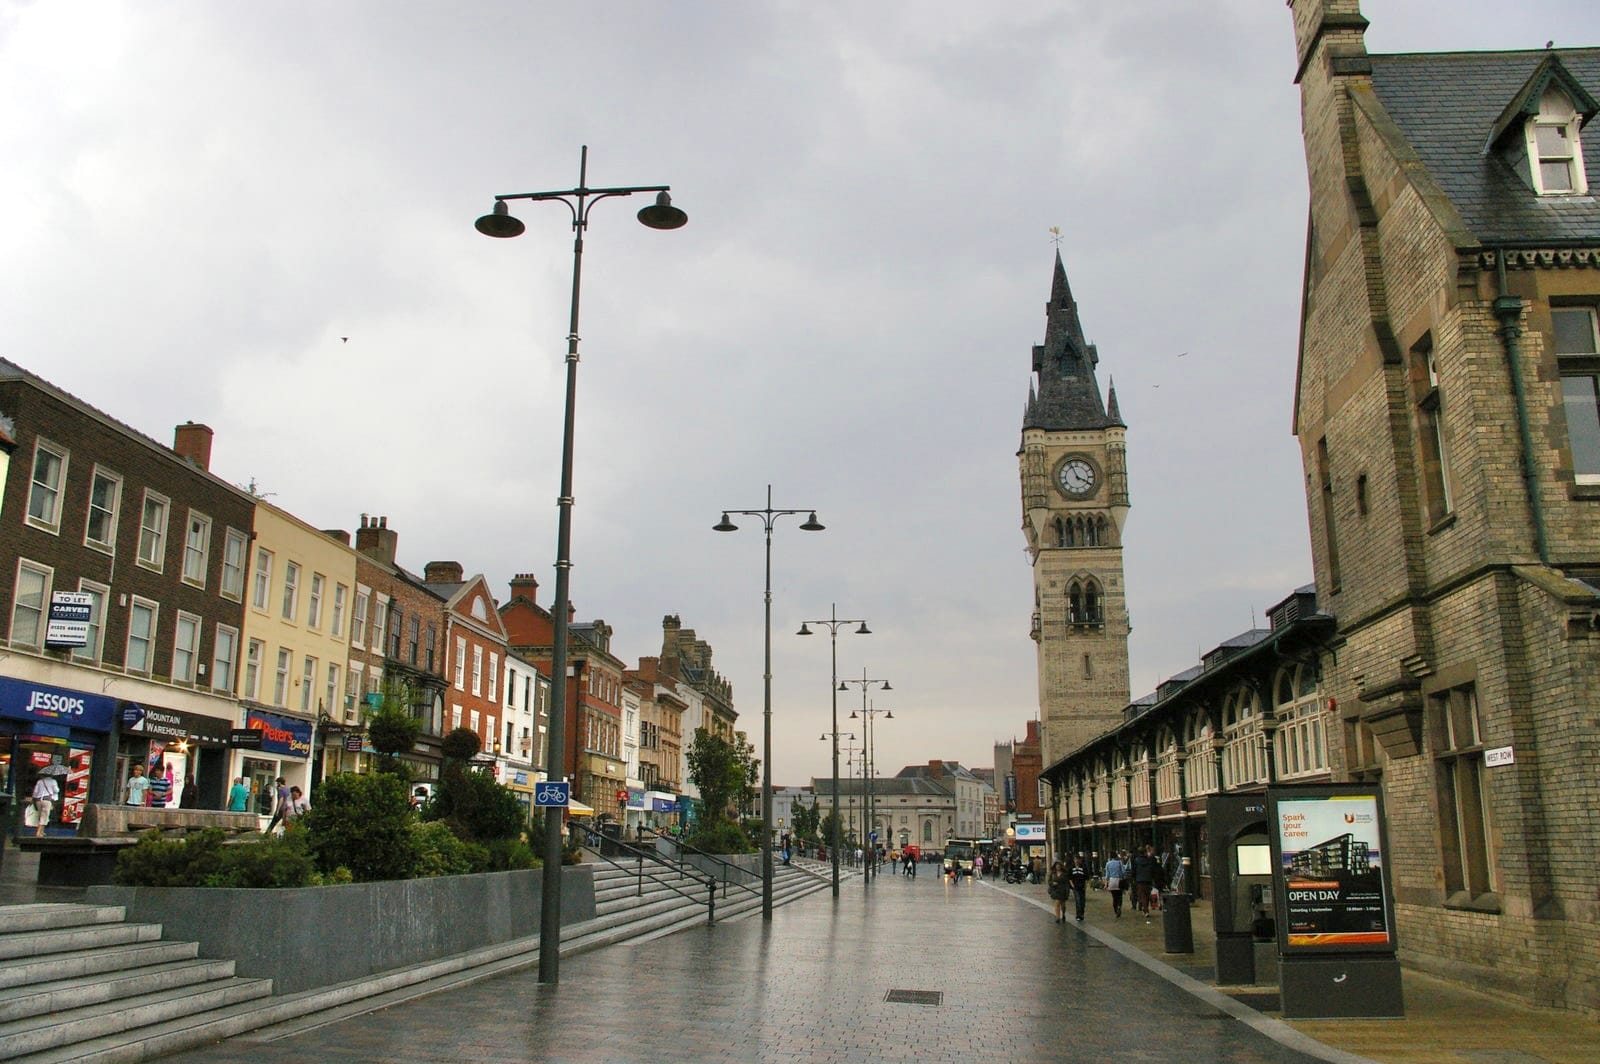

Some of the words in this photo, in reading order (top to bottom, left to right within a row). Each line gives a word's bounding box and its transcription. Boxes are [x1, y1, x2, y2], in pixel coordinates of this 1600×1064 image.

[26, 691, 84, 715] JESSOPS
[1487, 752, 1499, 762] WEST
[1282, 813, 1306, 823] Spark
[1283, 822, 1302, 831] your
[1283, 830, 1309, 838] career
[1288, 890, 1317, 901] OPEN
[1318, 890, 1340, 901] DAY
